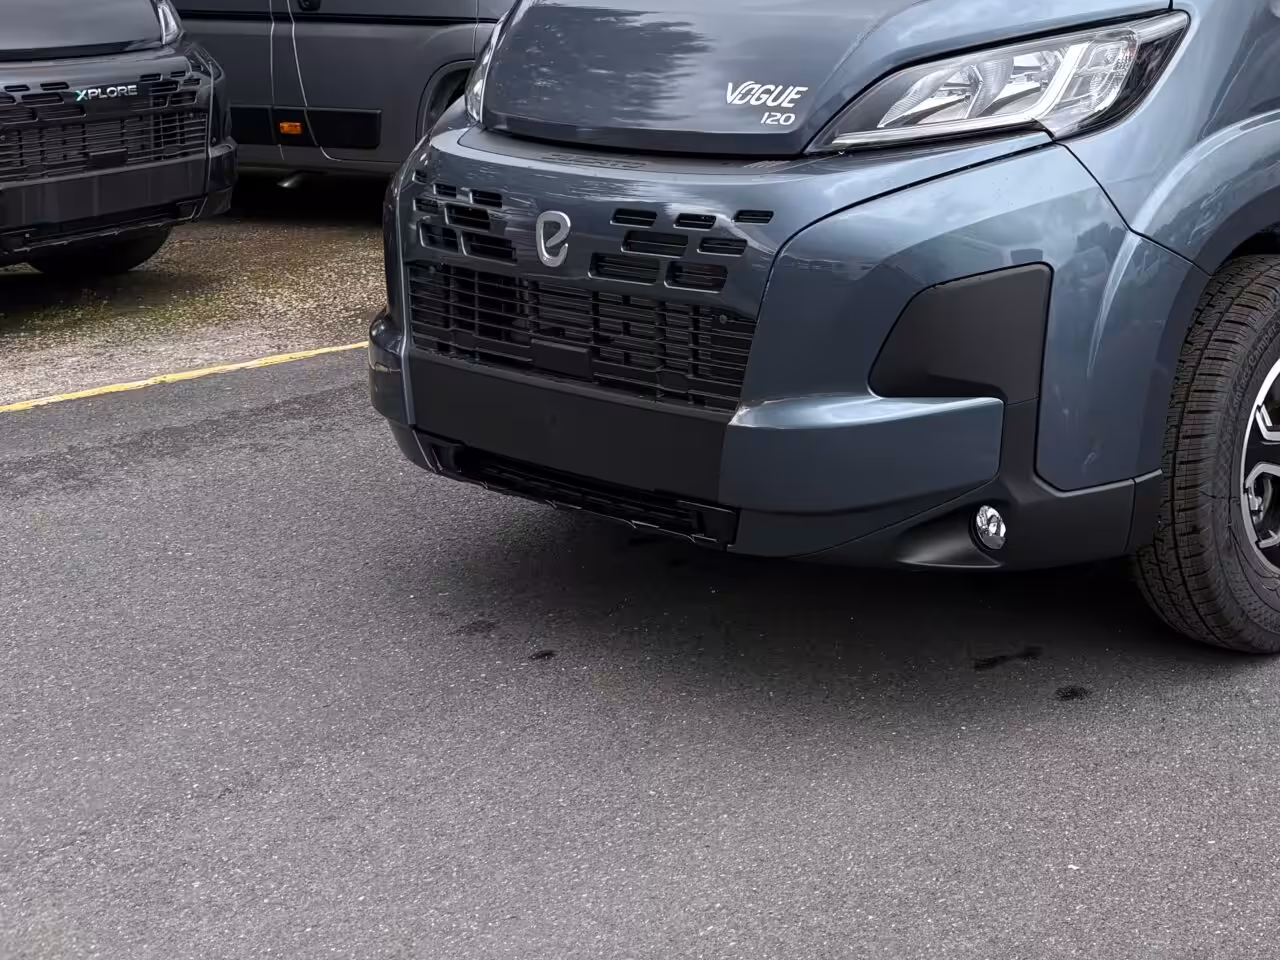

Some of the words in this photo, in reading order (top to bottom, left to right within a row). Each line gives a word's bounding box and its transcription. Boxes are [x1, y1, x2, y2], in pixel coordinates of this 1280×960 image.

[76, 85, 138, 101] XPLORE
[726, 81, 808, 108] VOGUE
[760, 112, 796, 125] 120
